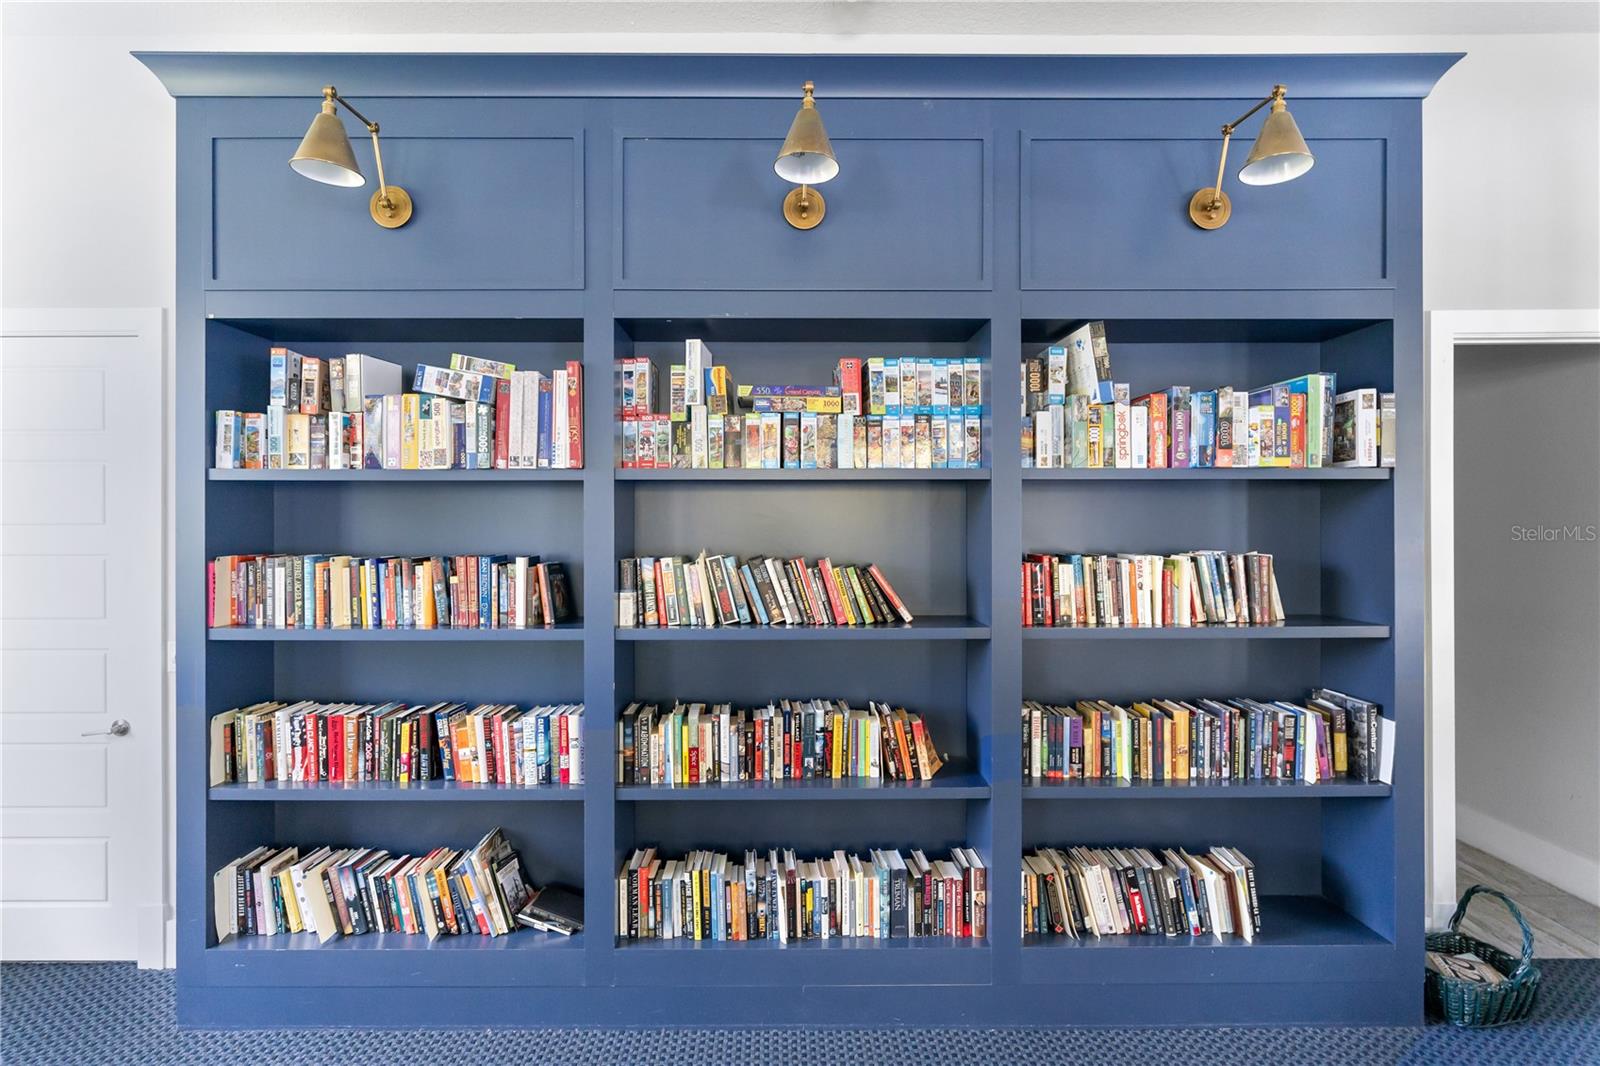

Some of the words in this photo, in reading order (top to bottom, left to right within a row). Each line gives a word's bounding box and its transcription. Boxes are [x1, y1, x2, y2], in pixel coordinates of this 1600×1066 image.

[1030, 372, 1041, 392] 1000
[823, 400, 840, 408] 1000
[1176, 412, 1184, 430] 1000
[478, 434, 488, 453] 500
[1119, 412, 1129, 460] springbok
[1220, 421, 1230, 446] 1000
[307, 730, 315, 754] CLANCY
[640, 730, 649, 767] ABOMINATION
[894, 878, 902, 911] TRUMAN
